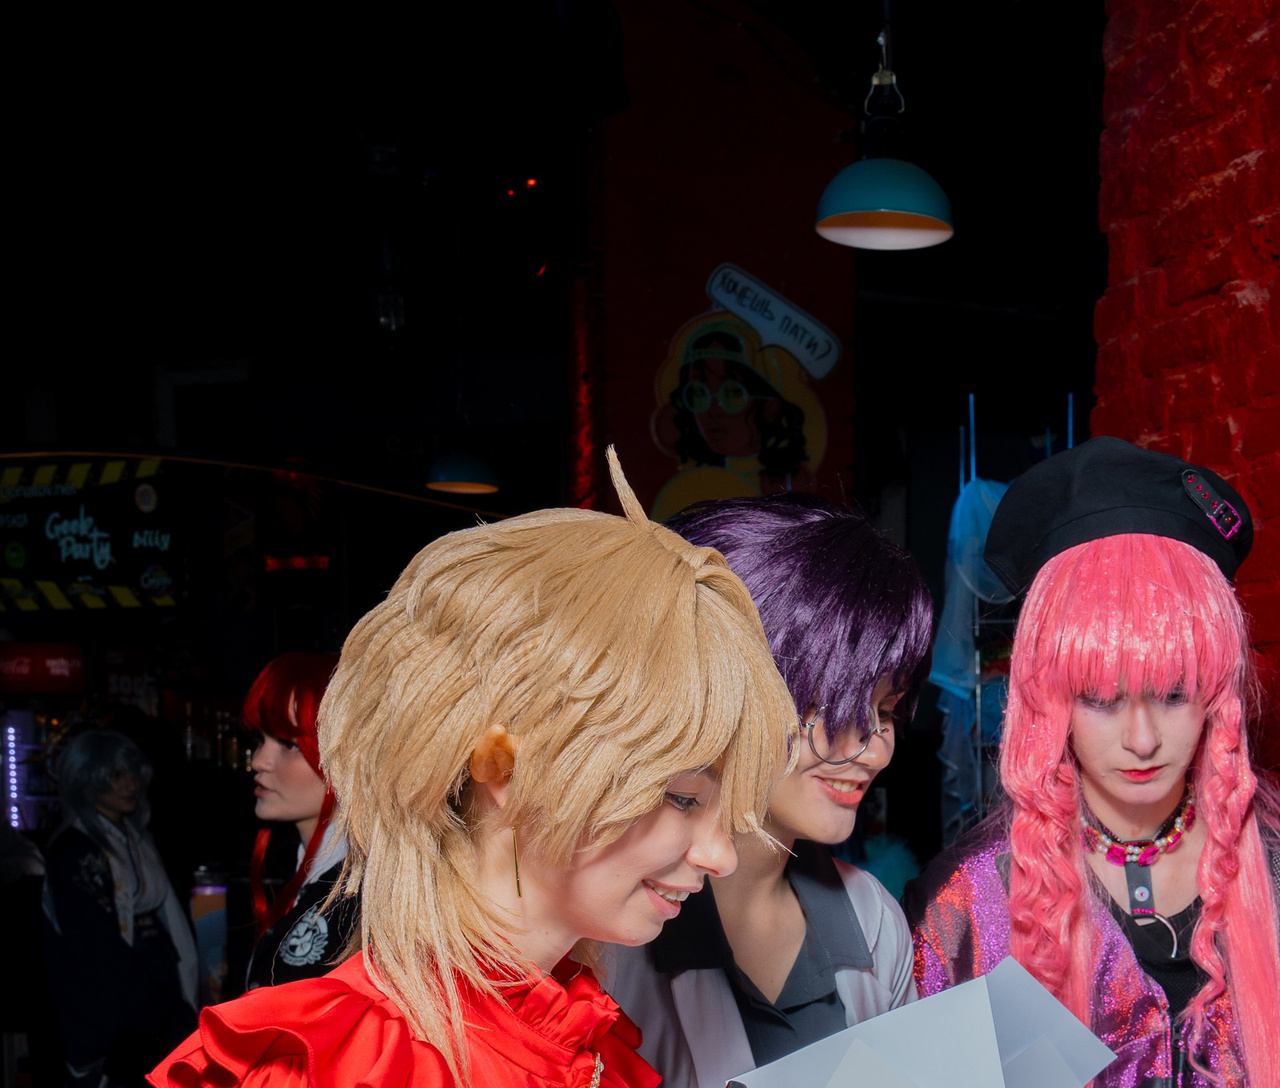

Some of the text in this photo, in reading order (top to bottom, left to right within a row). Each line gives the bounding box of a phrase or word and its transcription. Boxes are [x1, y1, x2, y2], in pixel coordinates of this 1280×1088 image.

[717, 271, 832, 362] ХОЧЕШЬ ПАТИ?
[44, 502, 95, 541] Geek
[57, 528, 117, 571] Party
